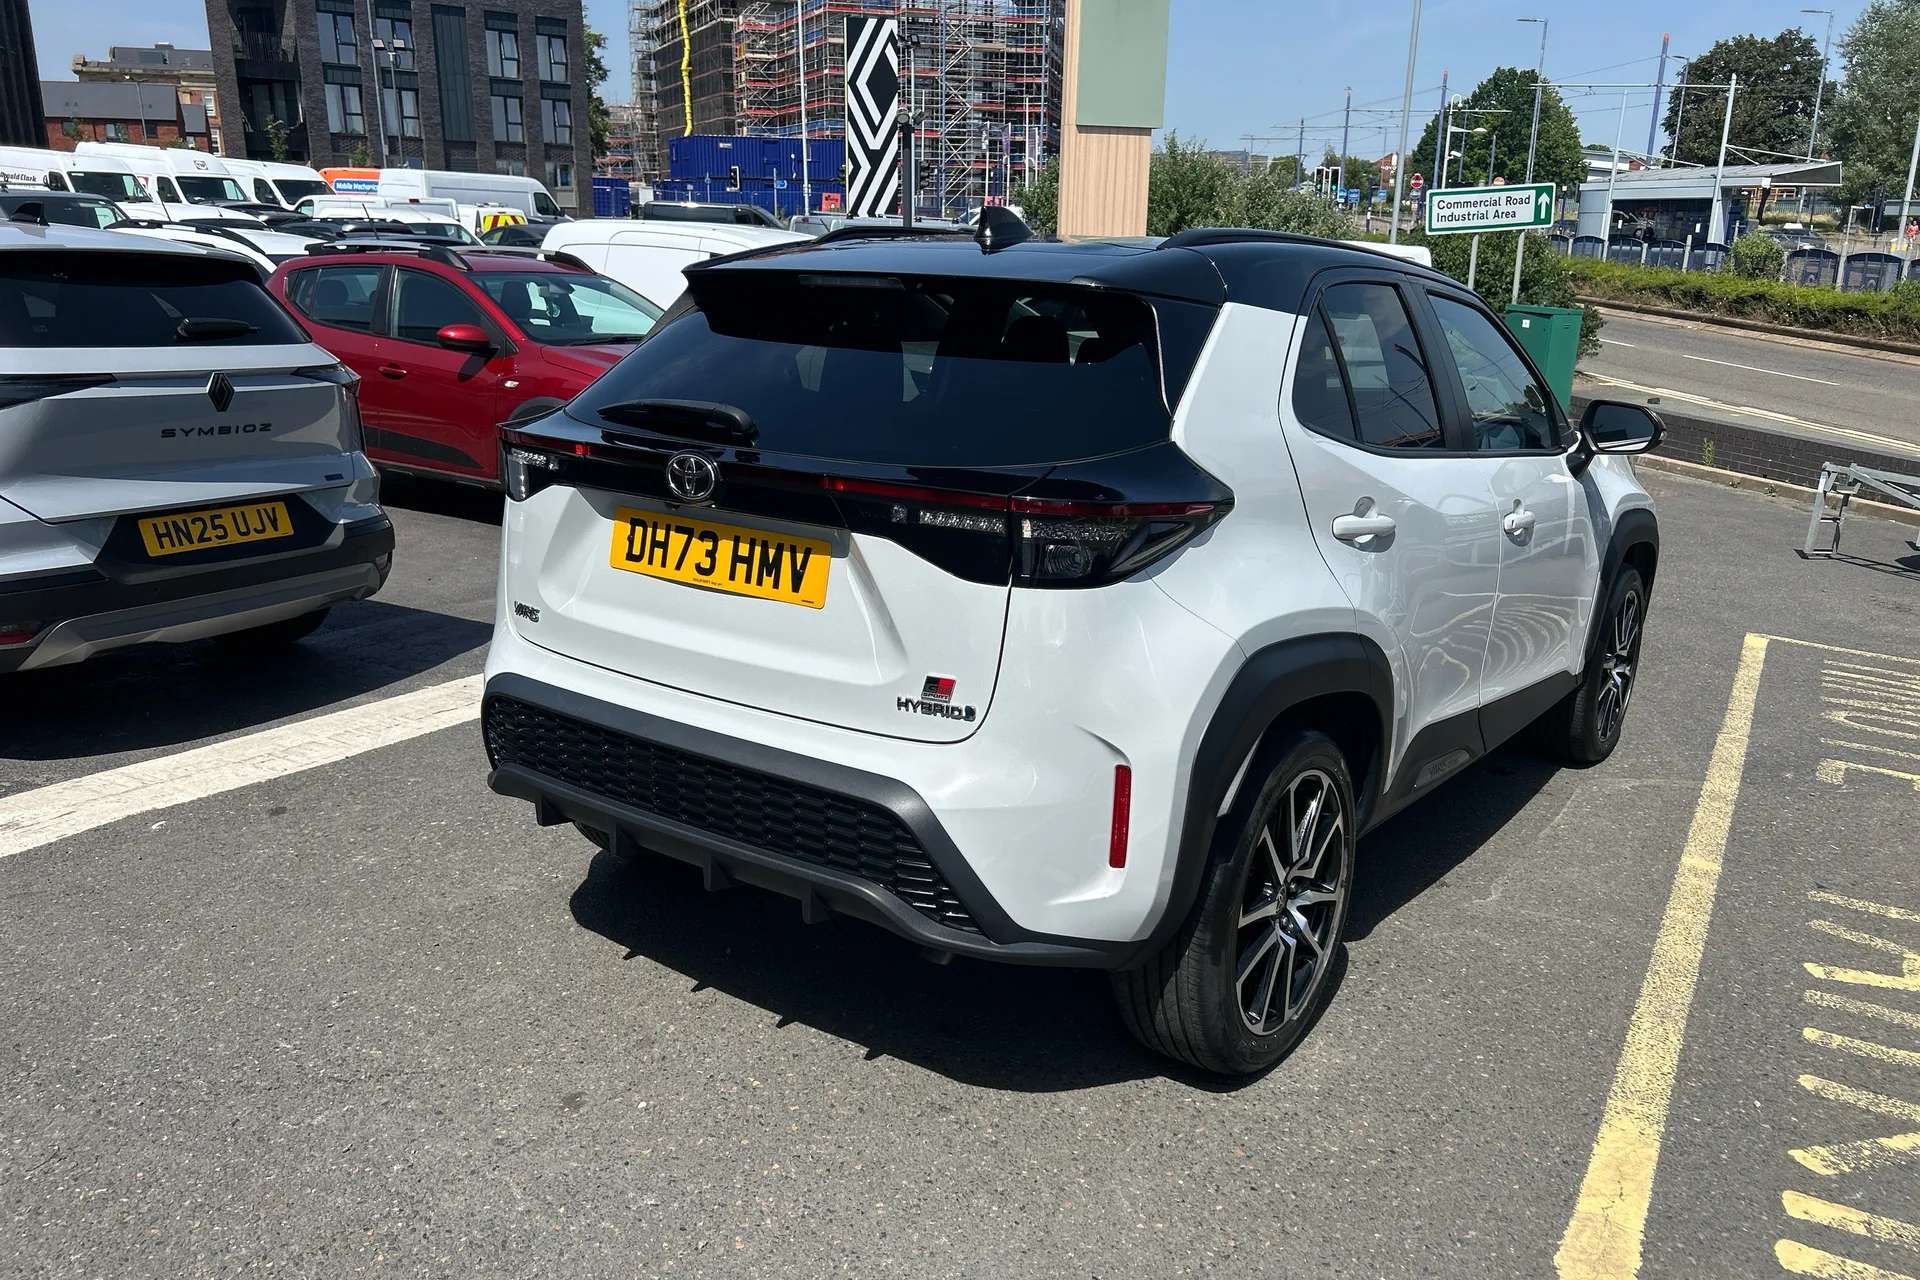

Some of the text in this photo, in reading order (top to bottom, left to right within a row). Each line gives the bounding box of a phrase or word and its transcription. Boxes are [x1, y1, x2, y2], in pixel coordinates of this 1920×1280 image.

[20, 173, 37, 182] Clark
[336, 182, 353, 190] Mobile
[1437, 195, 1531, 210] Commercial Road
[1437, 209, 1517, 223] Industrial Area
[160, 423, 272, 439] SYMBIOZ
[152, 507, 279, 550] HN25 UJV
[625, 517, 813, 594] DH73 HMV
[922, 691, 950, 700] SPORT
[896, 697, 964, 721] HYBRID
